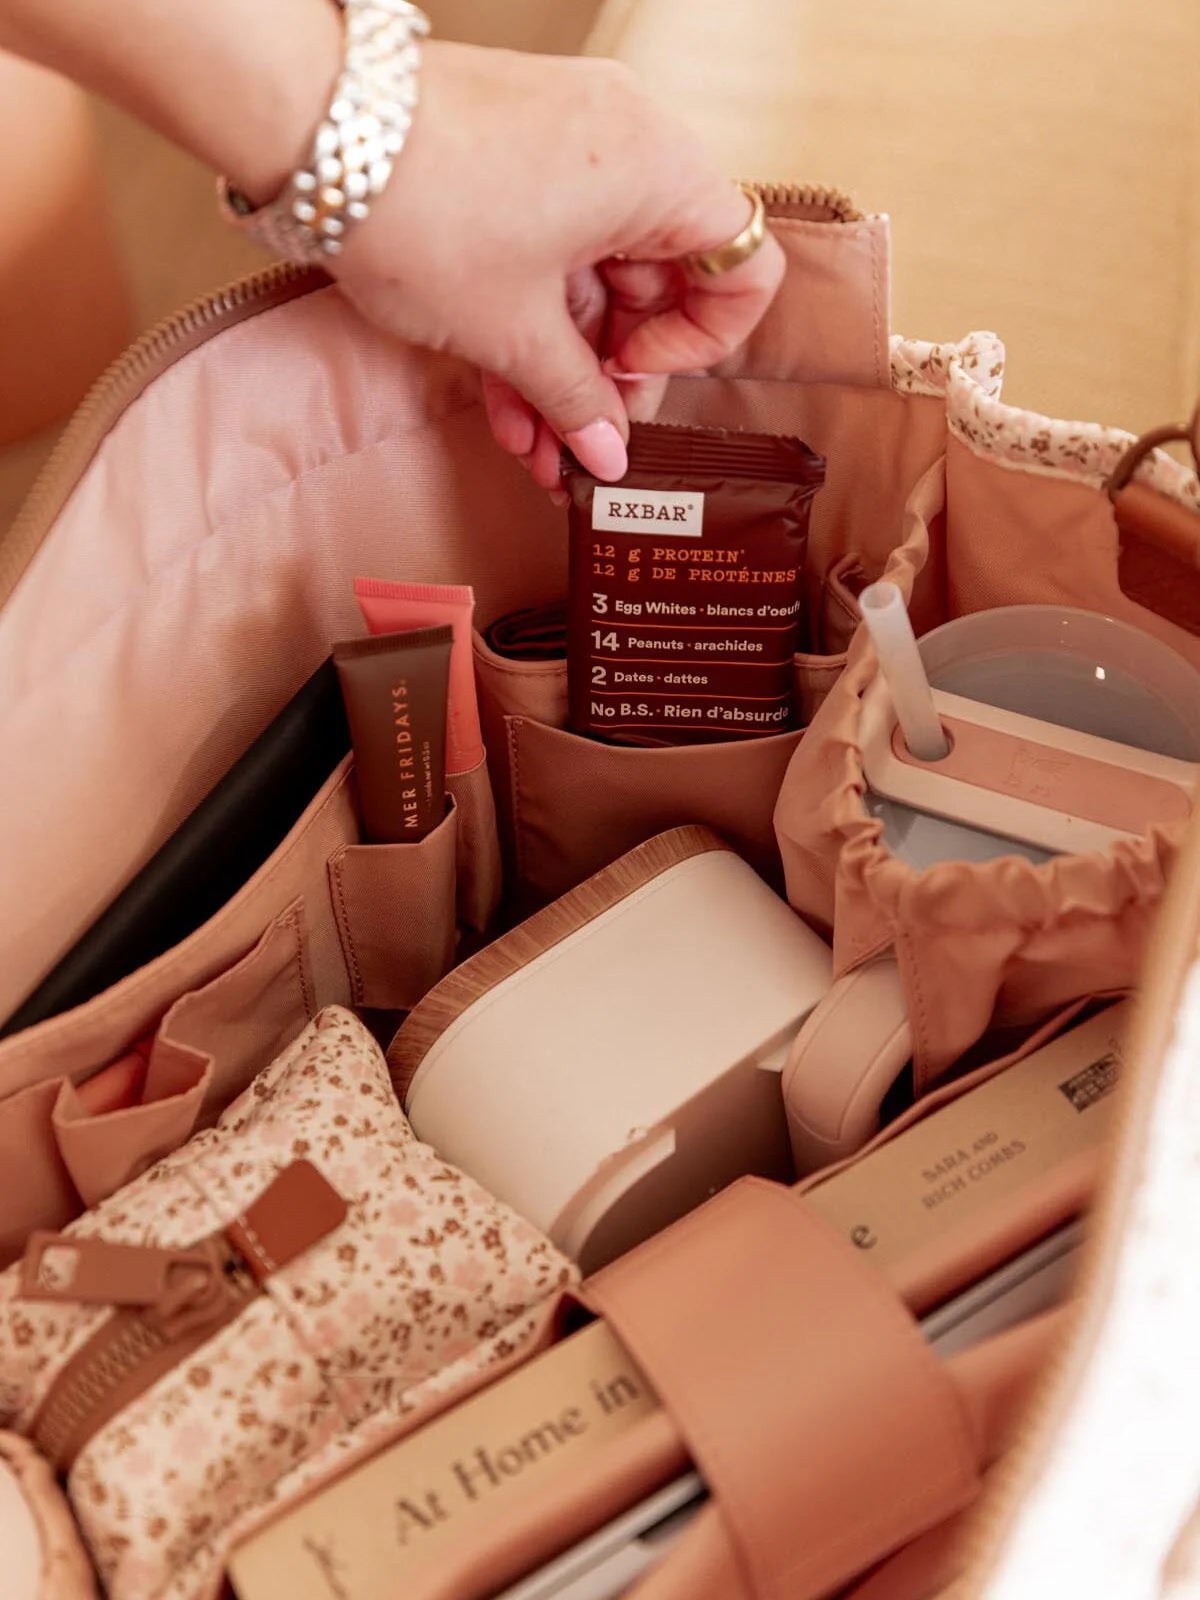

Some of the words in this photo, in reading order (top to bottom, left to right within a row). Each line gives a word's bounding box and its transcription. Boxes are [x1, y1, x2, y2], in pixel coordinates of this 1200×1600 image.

[593, 544, 615, 558] 12
[628, 548, 641, 563] g
[593, 563, 615, 576] 12
[627, 568, 640, 581] g
[652, 568, 676, 580] DE
[592, 593, 608, 614] 3
[615, 600, 642, 616] Egg
[646, 601, 697, 616] Whites
[707, 604, 753, 616] blancs
[591, 630, 620, 651] 14
[628, 637, 684, 650] Peanuts
[694, 639, 763, 651] arachides
[591, 666, 607, 685] 2
[614, 671, 654, 683] Dates
[663, 672, 708, 685] dattes
[591, 702, 615, 717] No
[620, 703, 653, 717] B.S.
[664, 705, 701, 718] Rien
[922, 1149, 971, 1183] SARA
[972, 1131, 999, 1153] AND
[922, 1176, 967, 1210] RICH
[968, 1139, 1027, 1182] COMBS
[395, 1486, 449, 1546] At
[450, 1407, 591, 1501] Home
[594, 1373, 640, 1415] in
